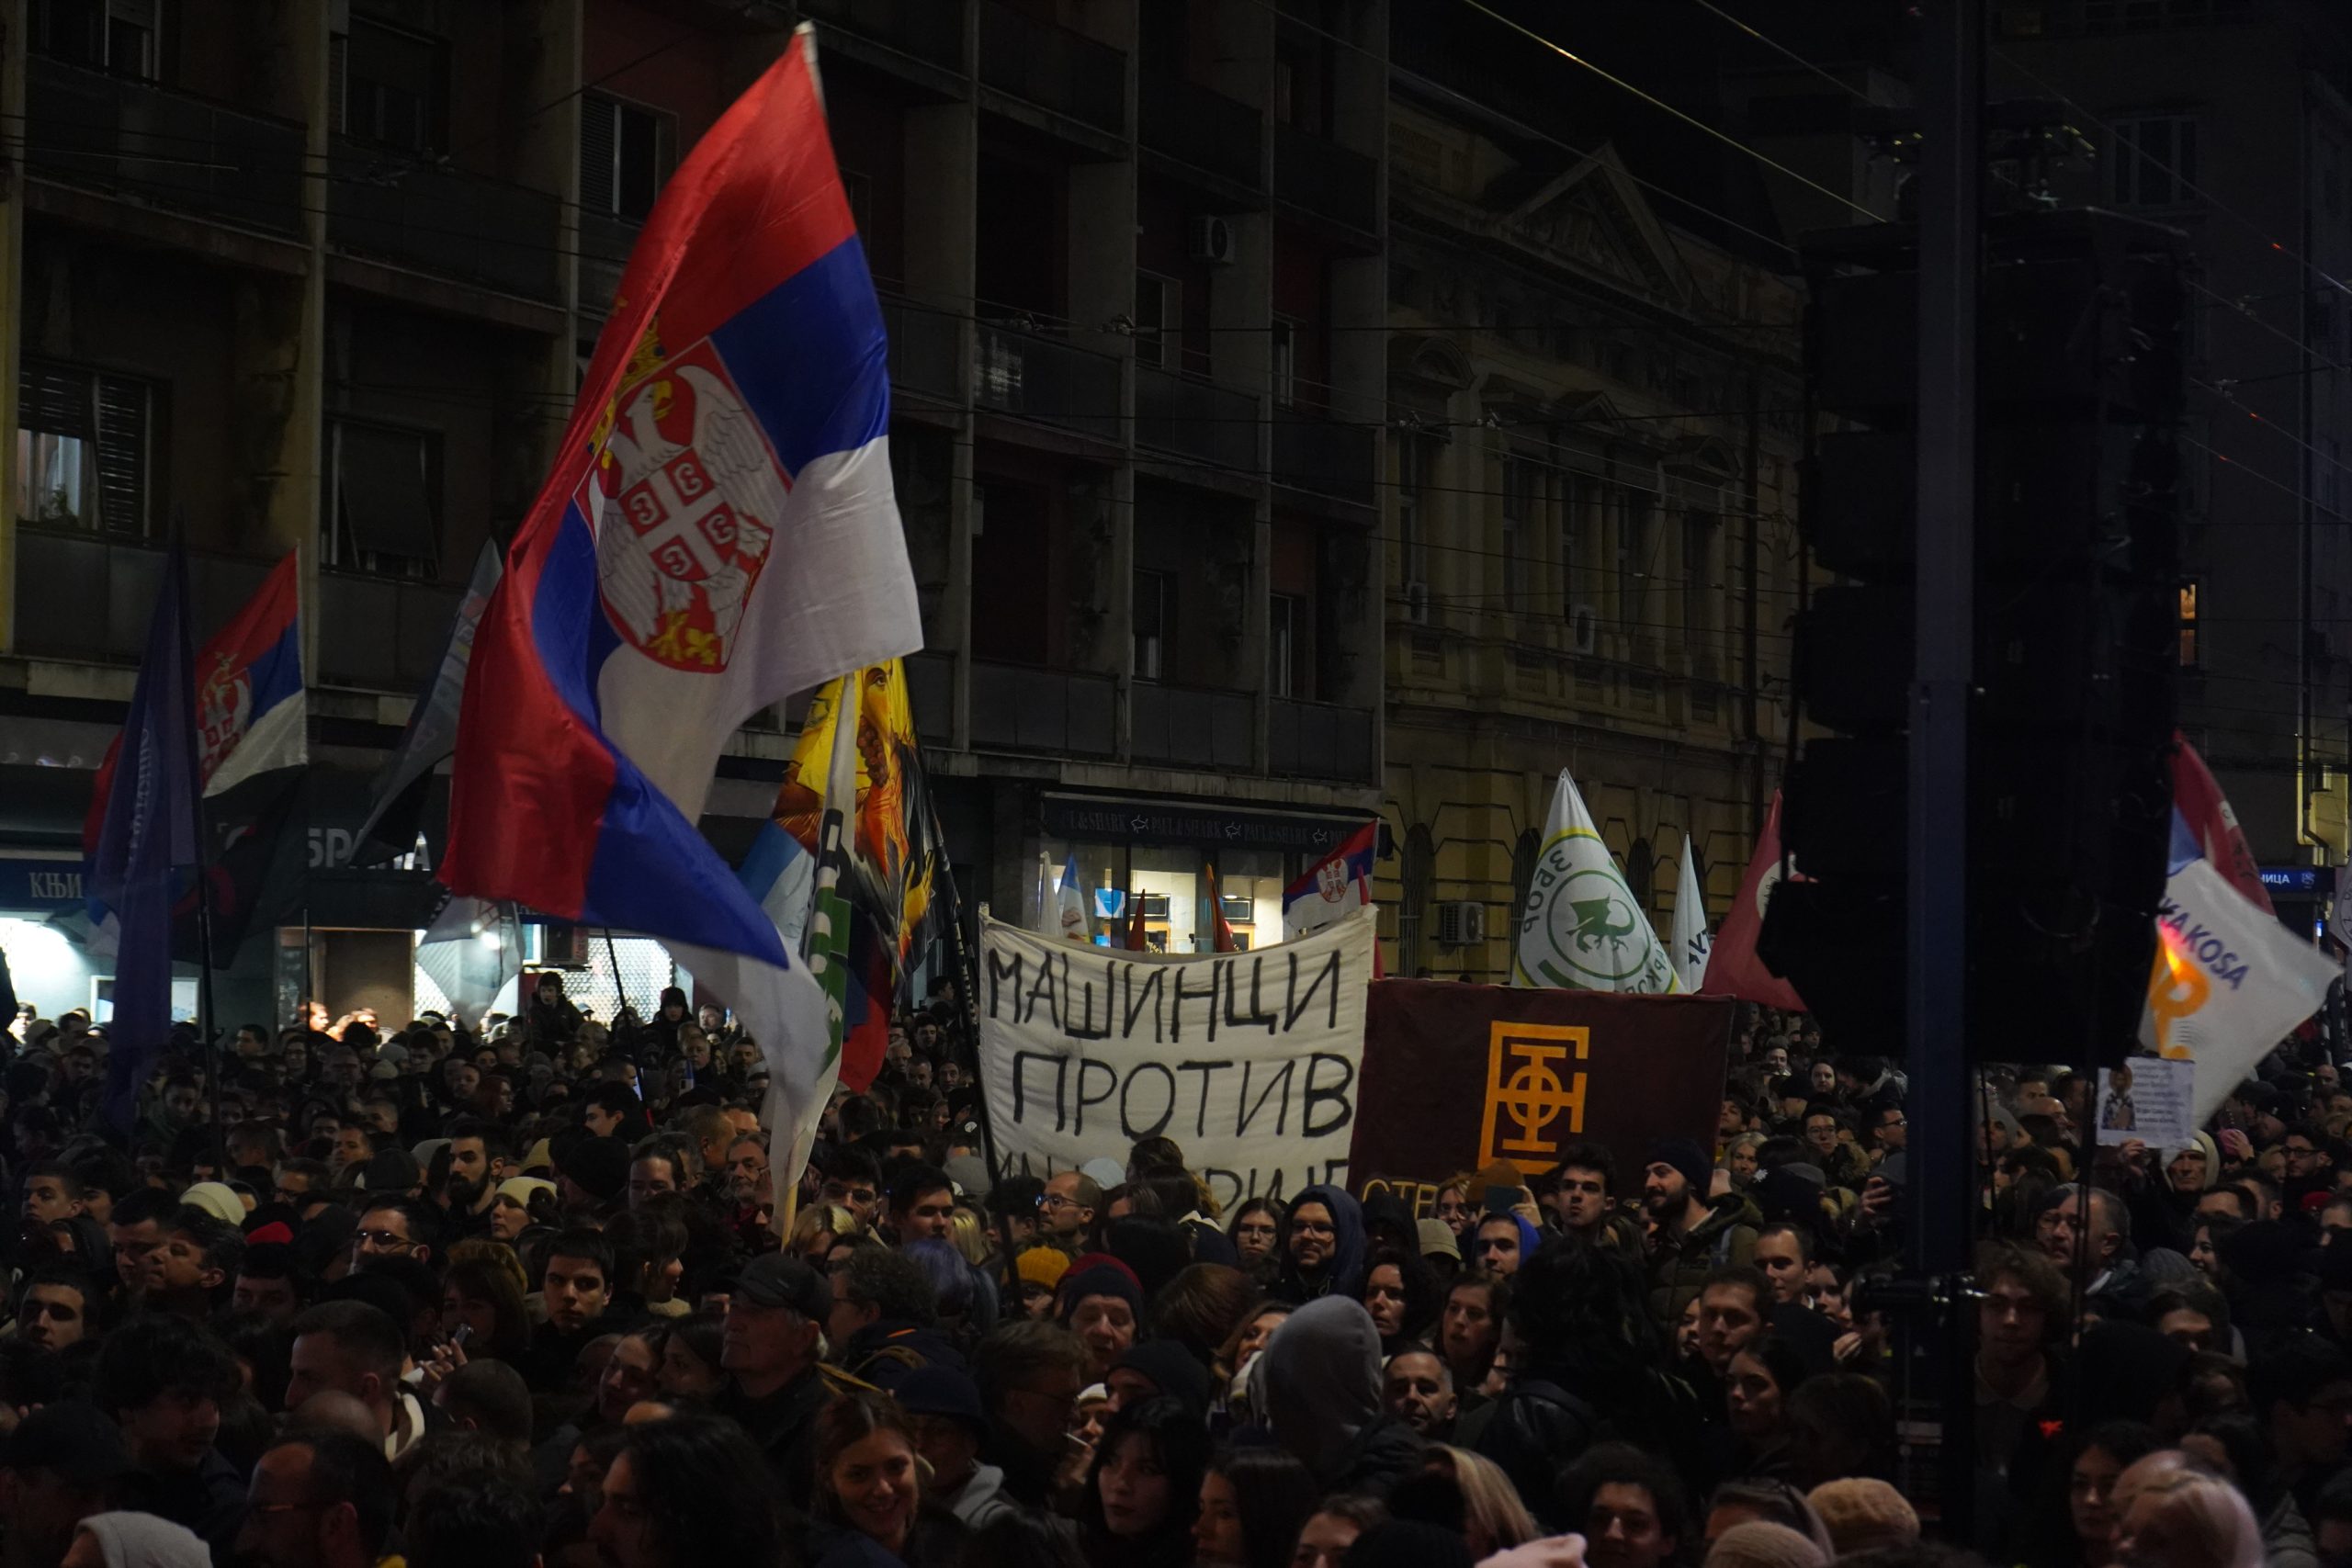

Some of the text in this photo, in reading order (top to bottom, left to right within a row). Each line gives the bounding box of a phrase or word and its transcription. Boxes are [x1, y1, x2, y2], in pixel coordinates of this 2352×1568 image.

[987, 947, 1340, 1043] МАШИНЦИ
[2180, 923, 2250, 991] KOSA
[1012, 1051, 1353, 1141] ПРОТИВ
